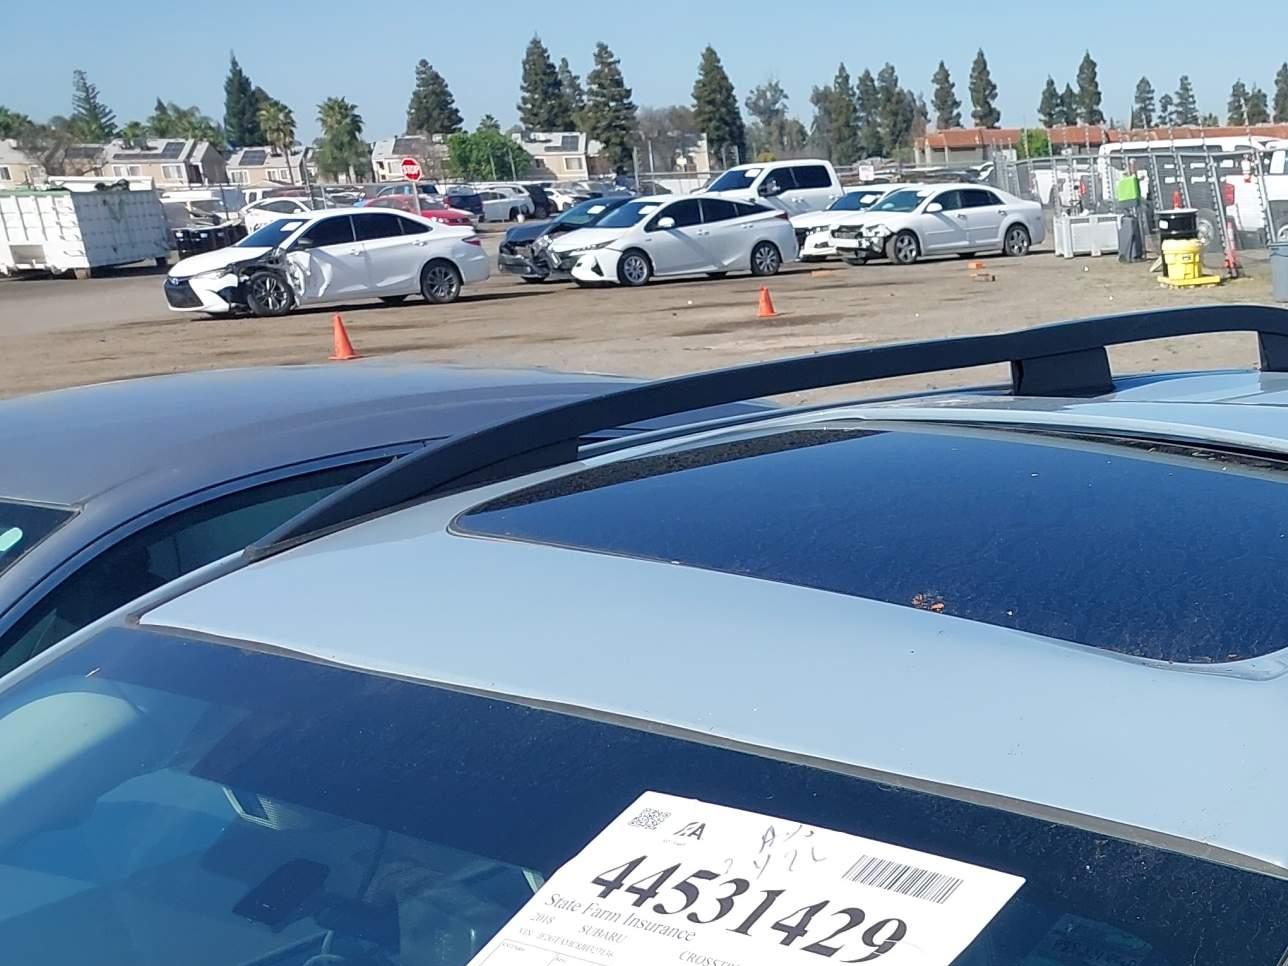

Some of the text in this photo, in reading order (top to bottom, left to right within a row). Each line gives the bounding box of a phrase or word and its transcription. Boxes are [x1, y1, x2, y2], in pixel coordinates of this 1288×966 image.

[545, 892, 697, 942] State Farm Insurance
[578, 924, 628, 944] SUBARU
[590, 854, 908, 964] 44531429
